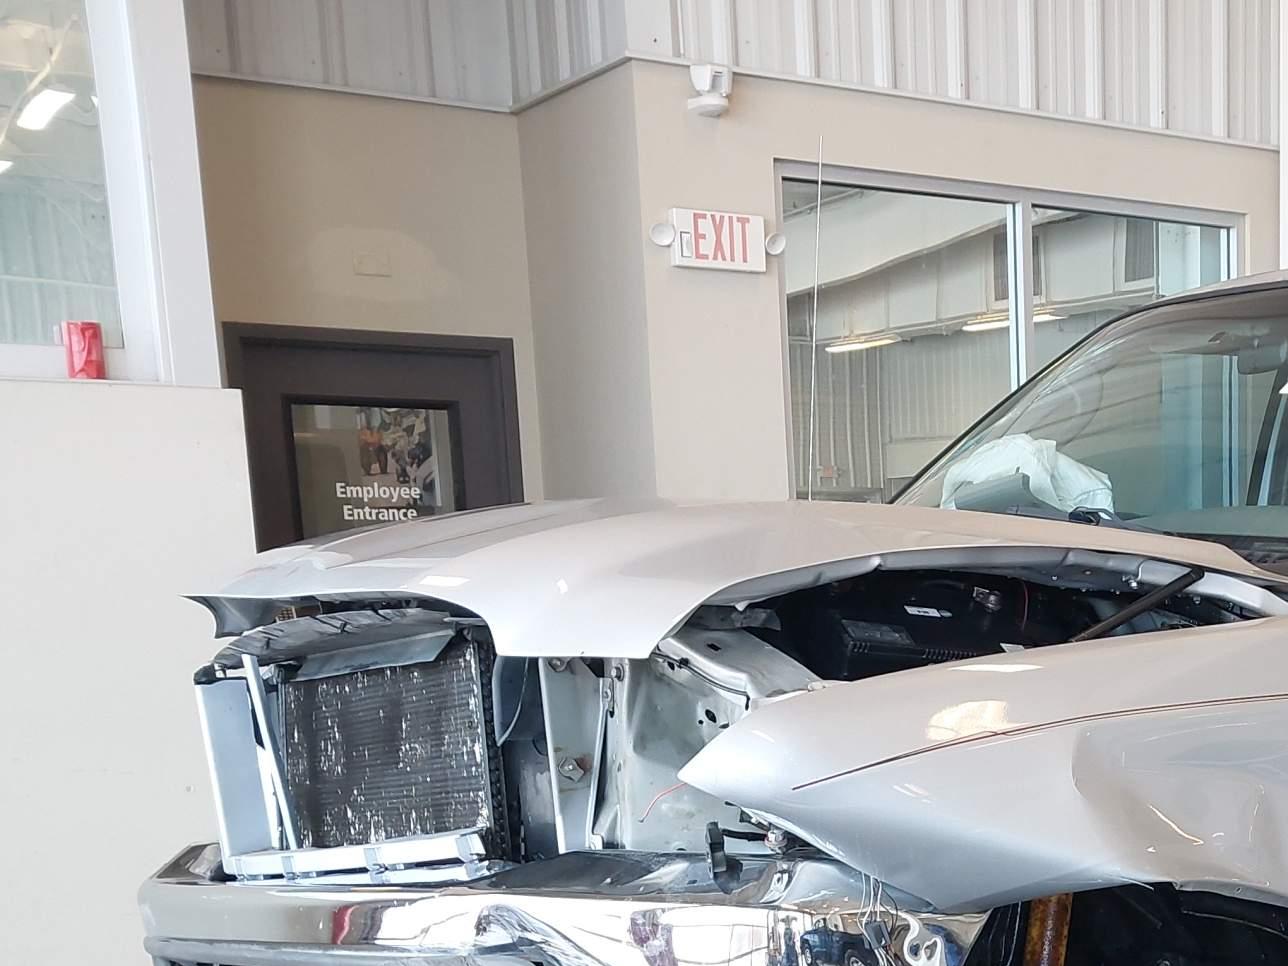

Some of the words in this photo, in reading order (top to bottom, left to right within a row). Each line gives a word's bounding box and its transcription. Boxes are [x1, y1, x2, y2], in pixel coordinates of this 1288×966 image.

[693, 212, 750, 263] EXIT
[335, 482, 421, 502] Employee
[343, 504, 418, 521] Entrance
